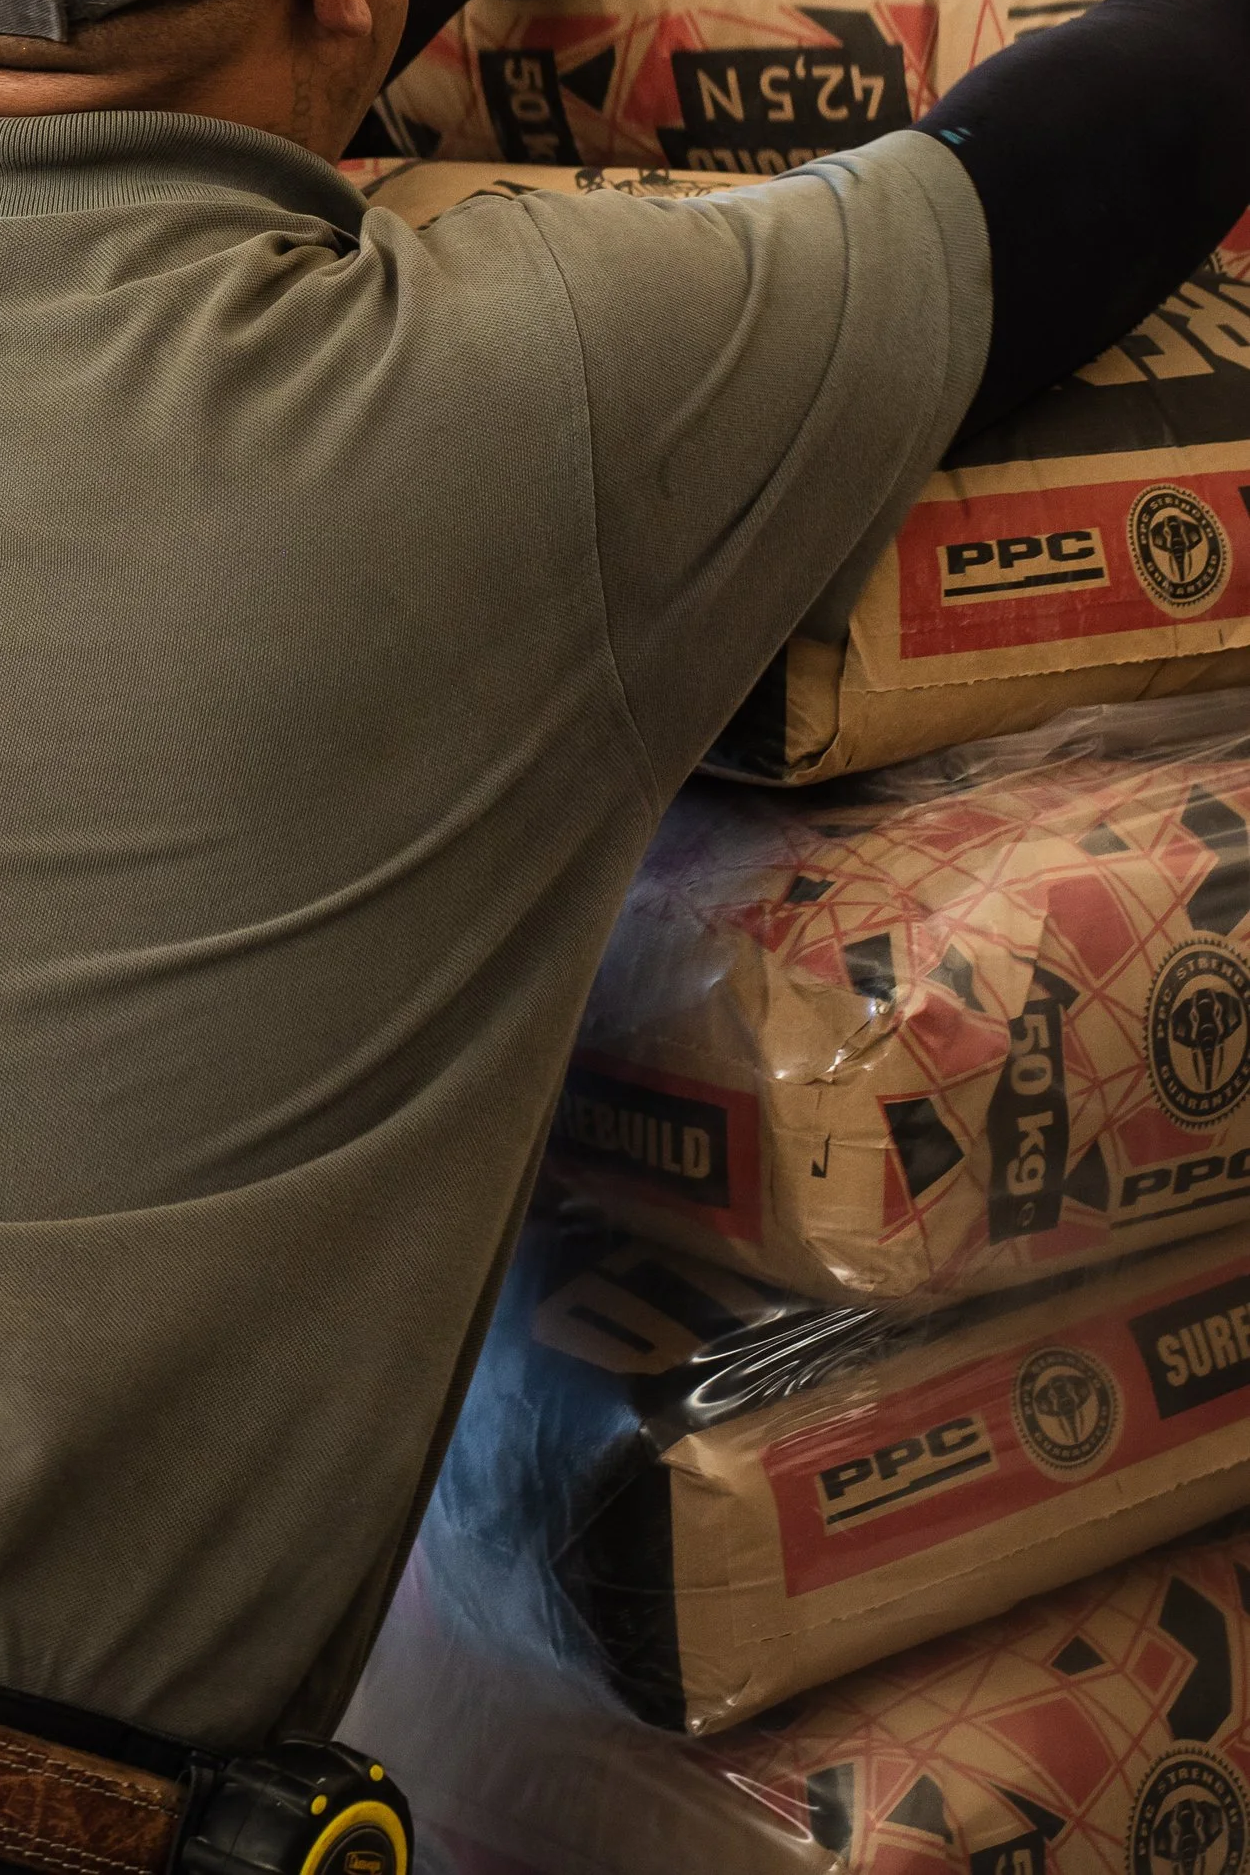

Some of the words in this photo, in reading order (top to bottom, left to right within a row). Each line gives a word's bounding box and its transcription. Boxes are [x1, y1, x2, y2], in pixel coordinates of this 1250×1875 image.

[504, 56, 550, 122] 50
[695, 65, 744, 122] N
[758, 52, 887, 122] 42,5
[945, 531, 1096, 575] PPC
[1009, 1014, 1054, 1096] 50
[1006, 1110, 1054, 1195] kg
[1156, 1302, 1250, 1387] SURE
[819, 1416, 980, 1501] PPC
